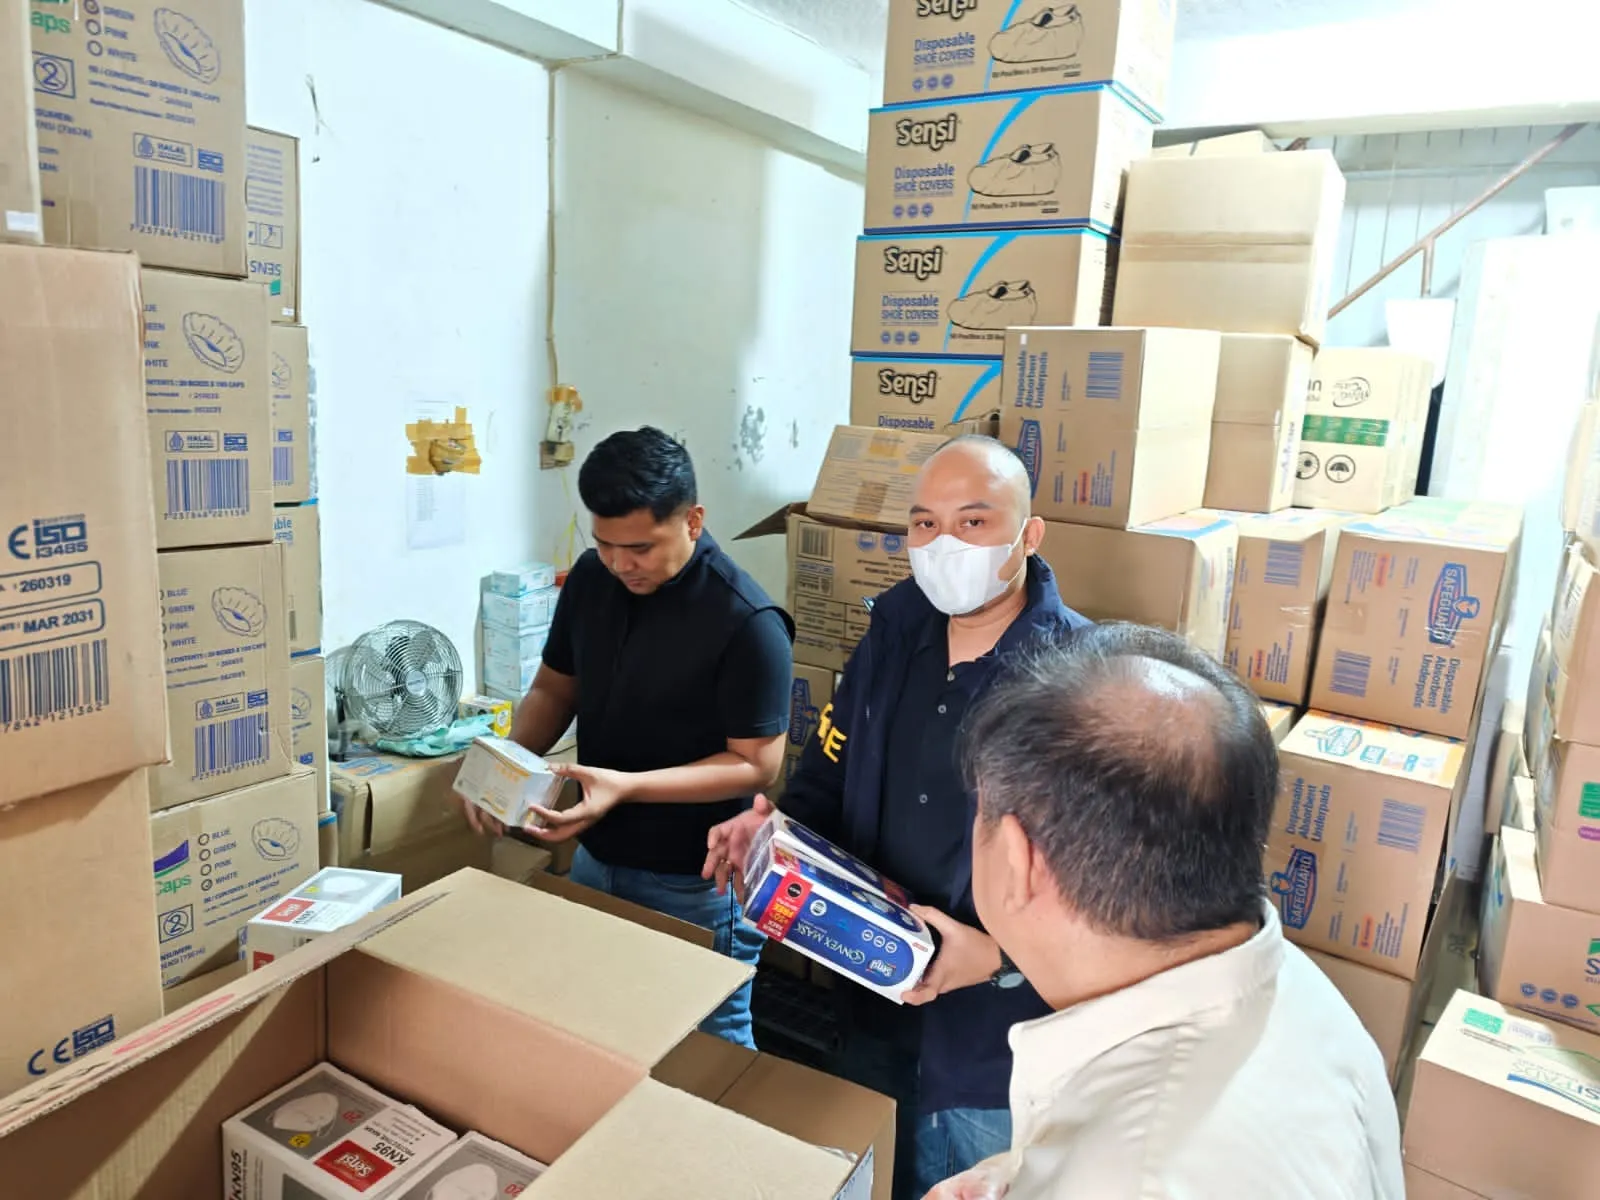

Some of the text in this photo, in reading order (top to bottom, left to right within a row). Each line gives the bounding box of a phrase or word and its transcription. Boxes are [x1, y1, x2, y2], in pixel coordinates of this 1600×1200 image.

[914, 32, 975, 51] Disposable
[914, 48, 975, 65] SHOE COVERS
[895, 112, 958, 151] Sensi
[894, 164, 954, 179] Disposable
[894, 178, 954, 192] SHOE COVERS
[884, 245, 944, 281] Sensi
[882, 294, 938, 308] Disposable
[881, 309, 938, 320] SHOE COVERS
[878, 368, 938, 404] Sensi
[1014, 350, 1027, 407] Disposable
[1025, 354, 1037, 408] Absorbent
[1035, 352, 1048, 408] Underpads
[878, 415, 935, 430] Disposable
[34, 519, 87, 546] ISO
[36, 542, 88, 559] 13485
[20, 573, 71, 592] 260319
[167, 588, 189, 598] BLUE
[168, 604, 195, 615] GREEN
[1432, 568, 1457, 643] SAFEGUARD
[24, 616, 59, 633] MAR
[62, 608, 93, 625] 2031
[171, 636, 197, 647] WHITE
[1413, 654, 1433, 709] Underpads
[1427, 655, 1446, 708] Absorbent
[1439, 658, 1461, 714] Disposable
[1285, 777, 1305, 835] Disposable
[1298, 784, 1317, 840] Absorbent
[1311, 785, 1332, 843] Underpads
[212, 827, 231, 840] BLUE
[213, 841, 237, 854] GREEN
[214, 859, 232, 870] PINK
[215, 871, 239, 885] WHITE
[1290, 855, 1313, 924] SAFEGUARD
[795, 922, 865, 965] CONVEX MASK
[372, 1141, 409, 1166] KN95
[230, 1149, 243, 1200] KN95
